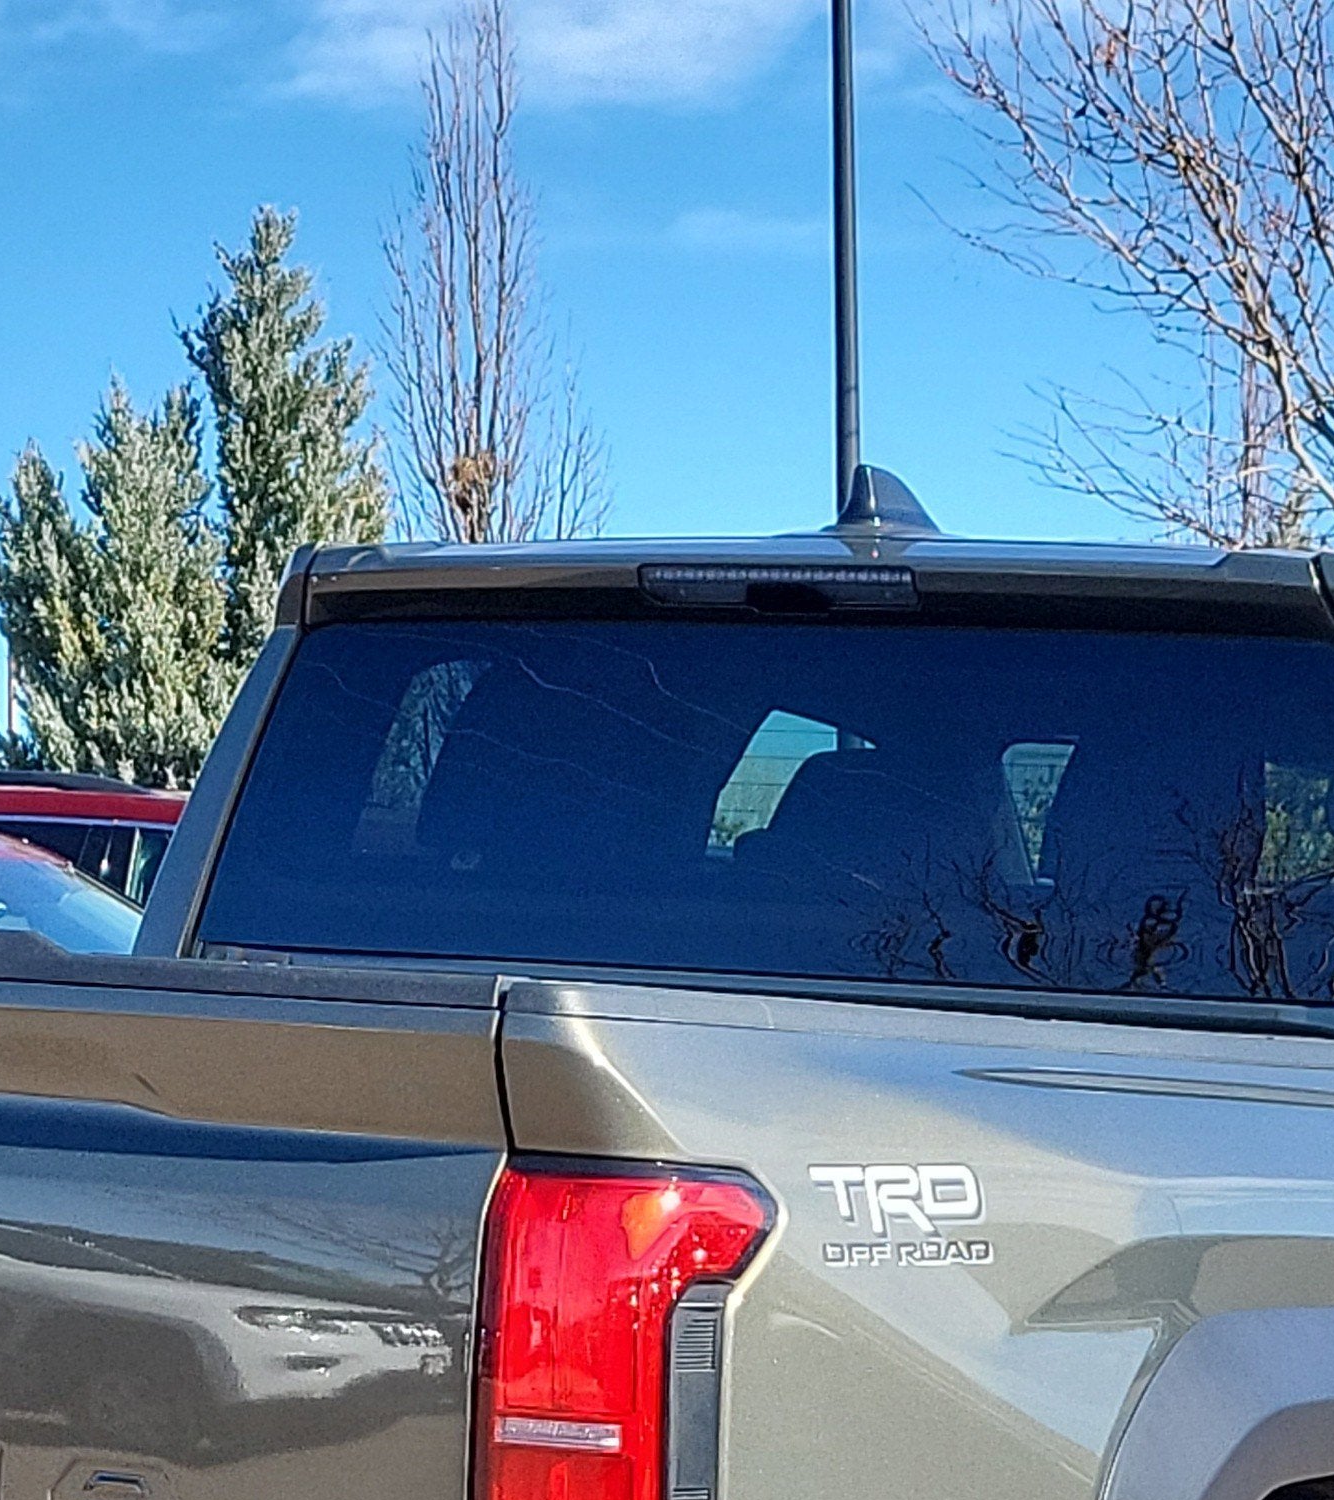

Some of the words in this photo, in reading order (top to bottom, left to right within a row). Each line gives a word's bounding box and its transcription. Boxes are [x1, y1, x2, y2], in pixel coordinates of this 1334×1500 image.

[807, 1163, 989, 1239] TRD
[823, 1242, 892, 1268] OFF
[896, 1239, 995, 1268] ROAD
